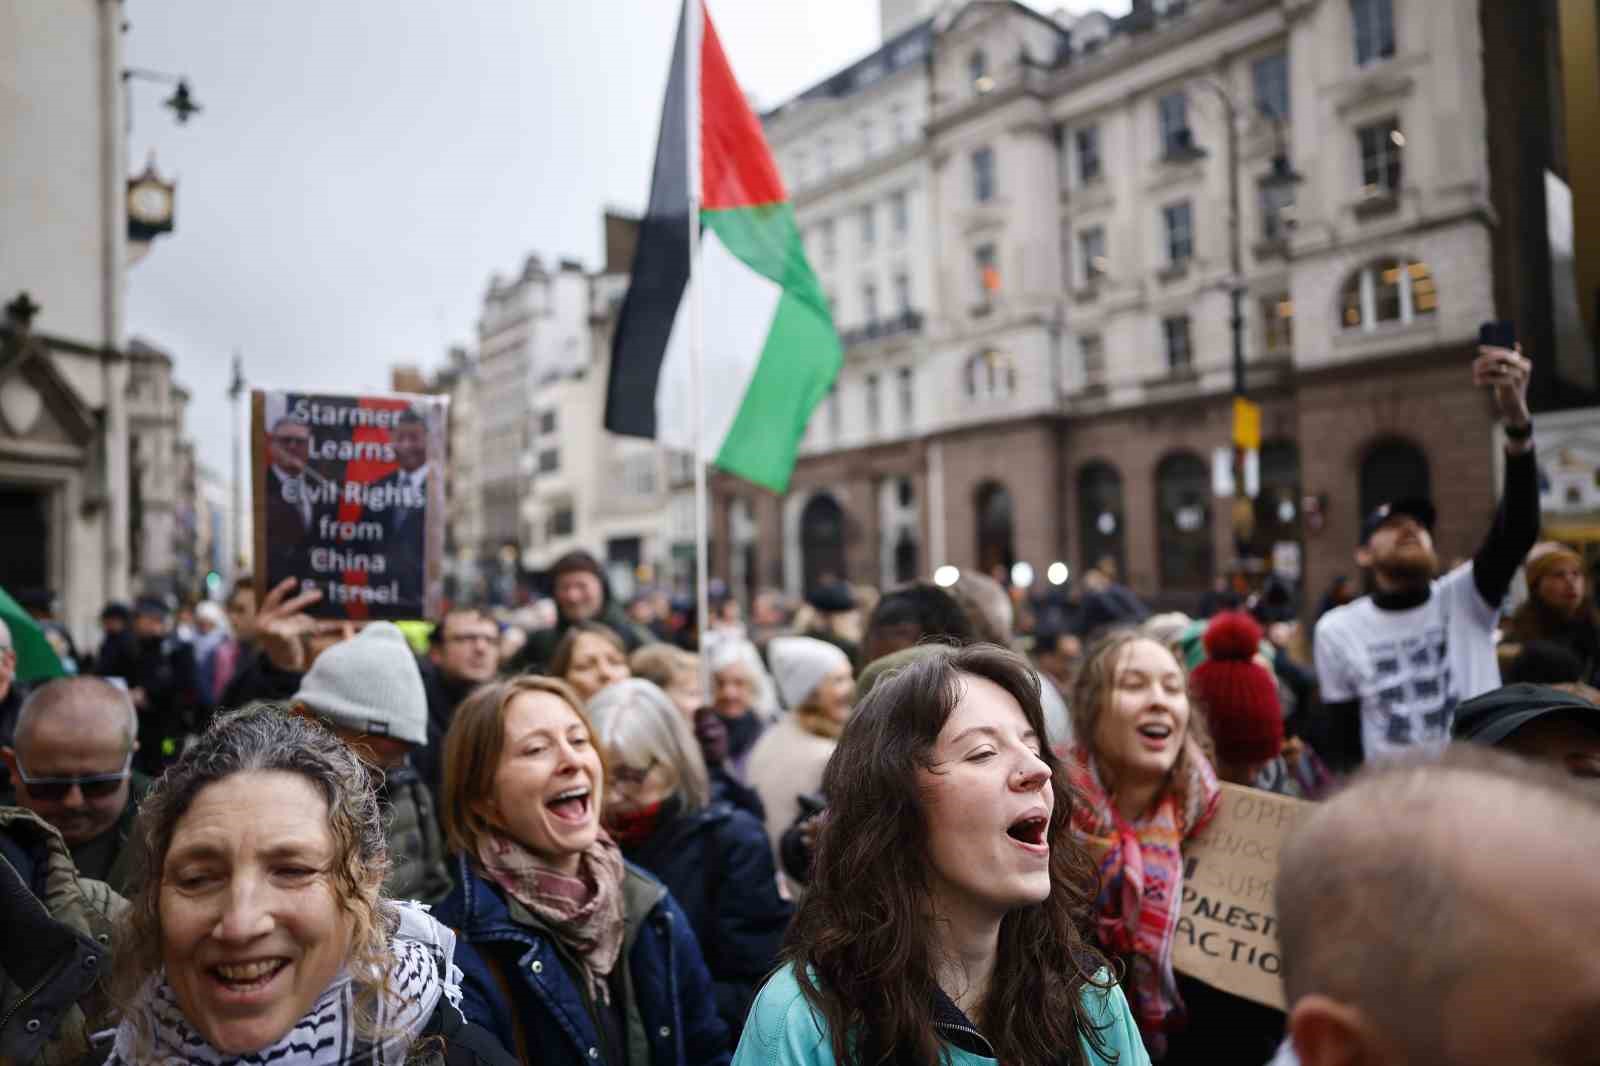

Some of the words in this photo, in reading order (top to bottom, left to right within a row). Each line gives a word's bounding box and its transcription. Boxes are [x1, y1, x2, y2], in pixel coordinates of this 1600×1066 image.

[295, 400, 401, 426] Starmer
[308, 436, 397, 461] Learns
[281, 478, 337, 504] Civil
[345, 480, 425, 511] Rights
[319, 514, 383, 539] from
[310, 547, 386, 572] China
[328, 579, 399, 604] Israel
